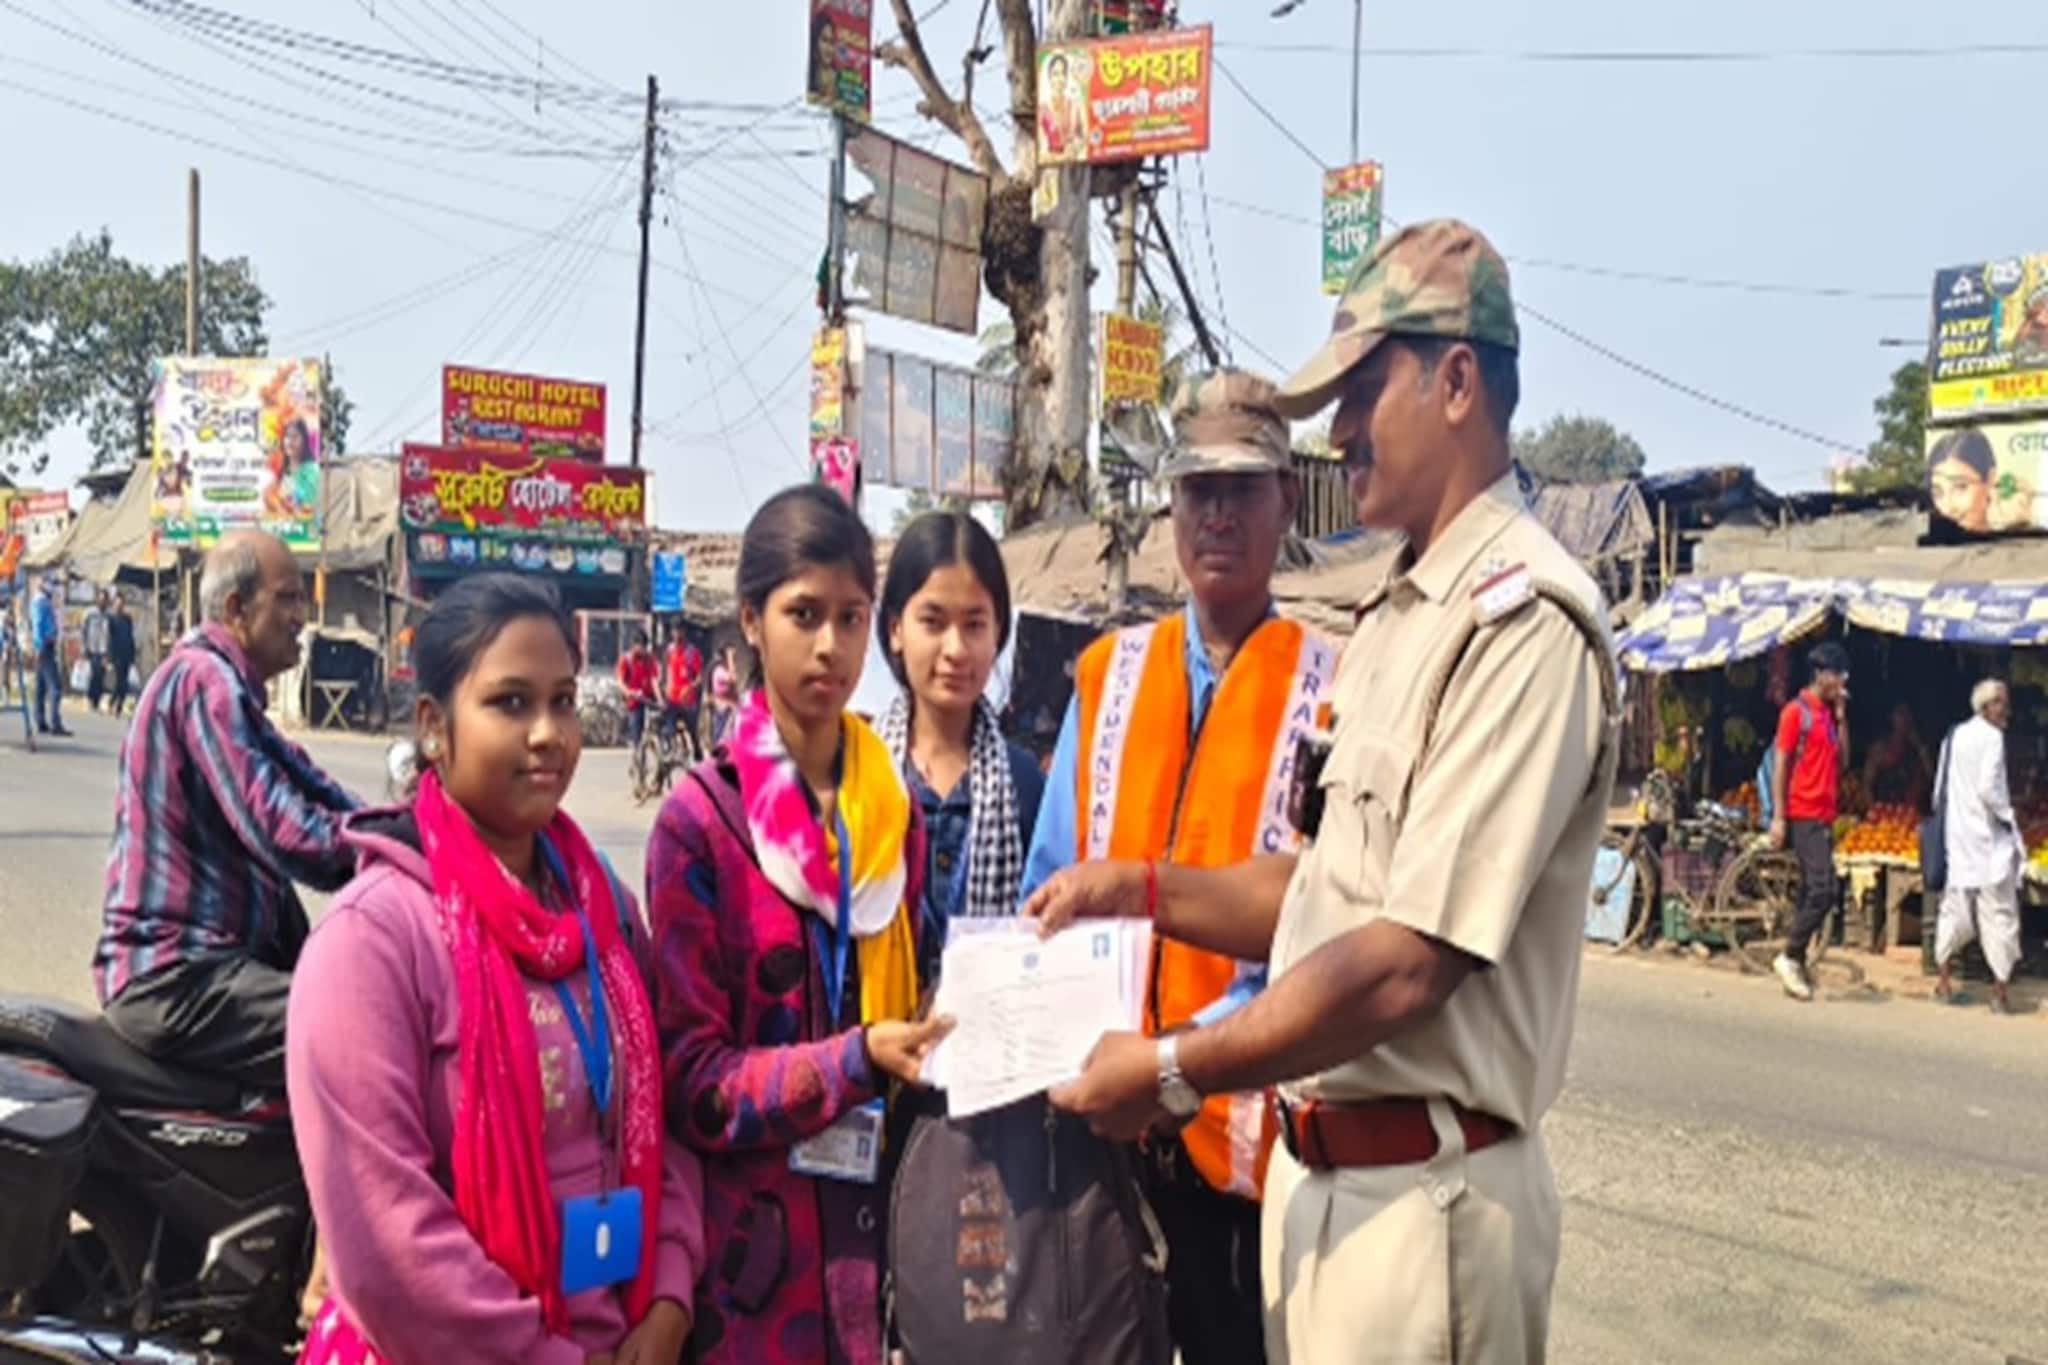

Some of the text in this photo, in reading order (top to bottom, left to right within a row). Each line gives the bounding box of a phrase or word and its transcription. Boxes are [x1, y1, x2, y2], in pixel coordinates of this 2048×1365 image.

[1098, 45, 1200, 88] উপহার
[448, 369, 600, 409] SURUCHI HOTEL
[470, 397, 582, 427] RESTAURANT
